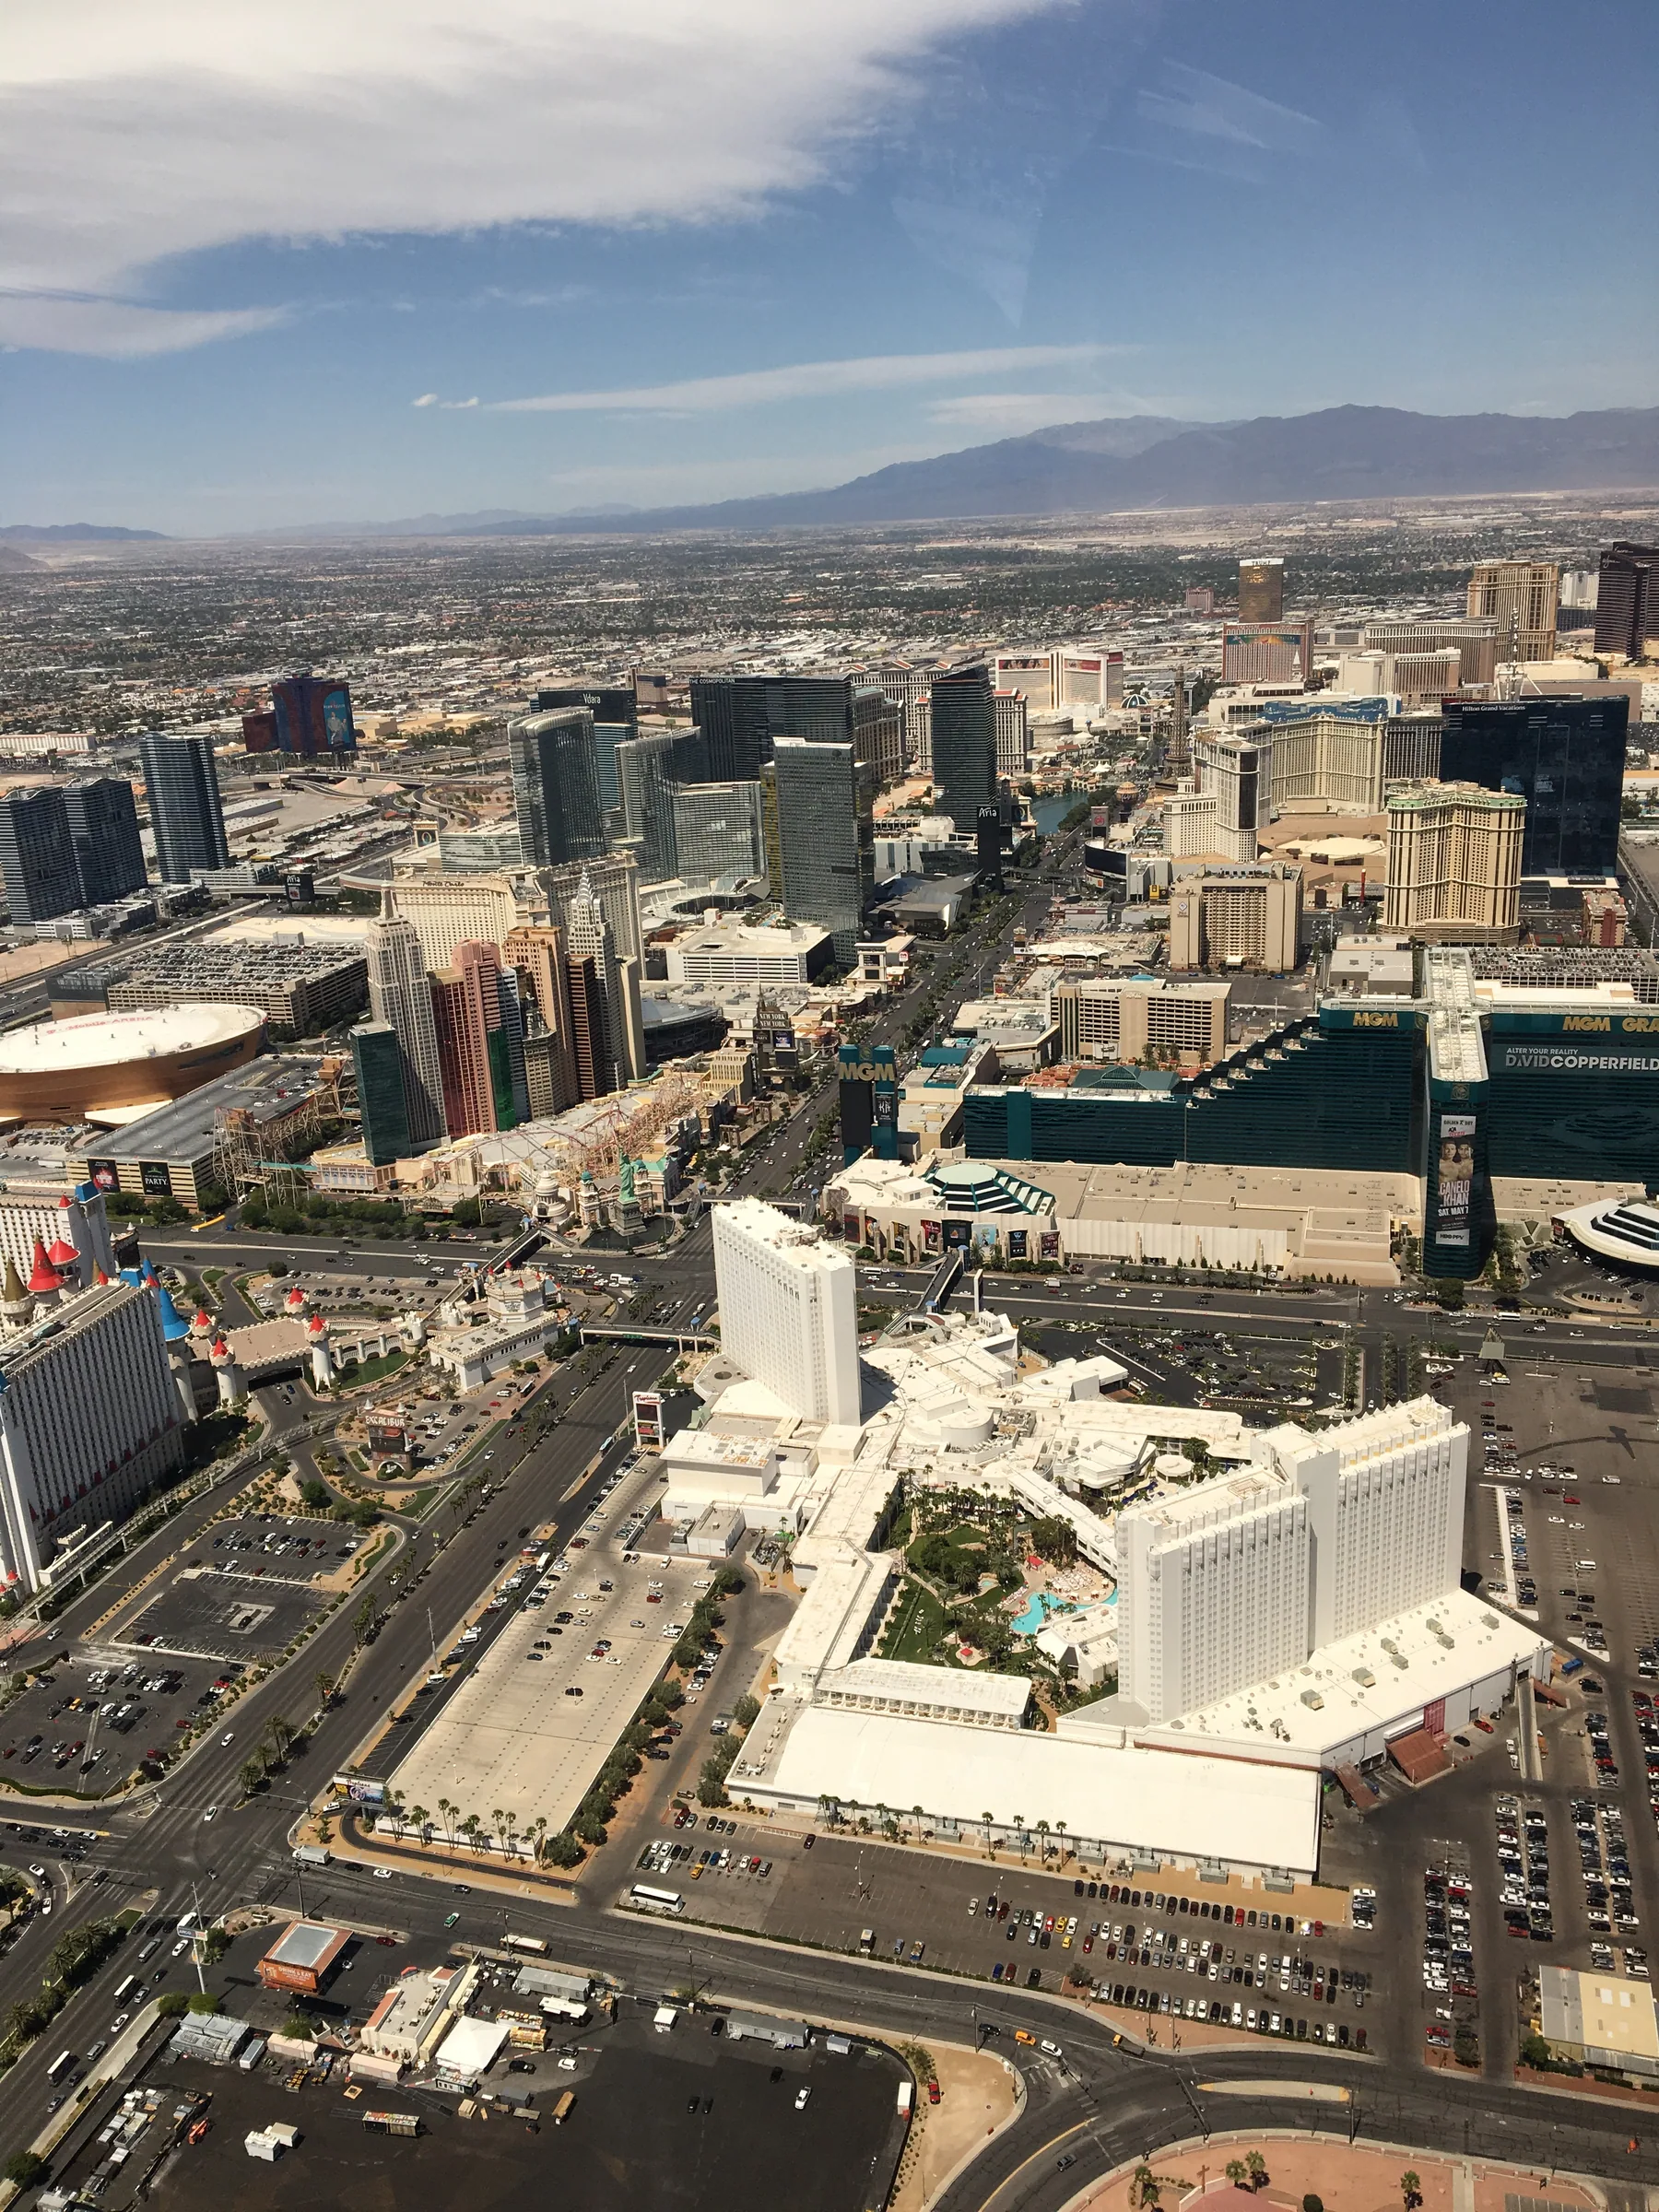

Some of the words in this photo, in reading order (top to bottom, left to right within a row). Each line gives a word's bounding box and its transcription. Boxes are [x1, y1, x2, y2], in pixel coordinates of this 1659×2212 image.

[583, 693, 600, 704] Vdara
[979, 807, 997, 818] Aria
[1353, 1012, 1398, 1027] MGM
[1563, 1016, 1611, 1032] MGM
[839, 1062, 895, 1081] MGM
[1440, 1180, 1470, 1195] CANELO
[1443, 1192, 1469, 1207] KHAN
[1451, 1207, 1464, 1215] MAY
[365, 1415, 405, 1427] EXCALIBUR
